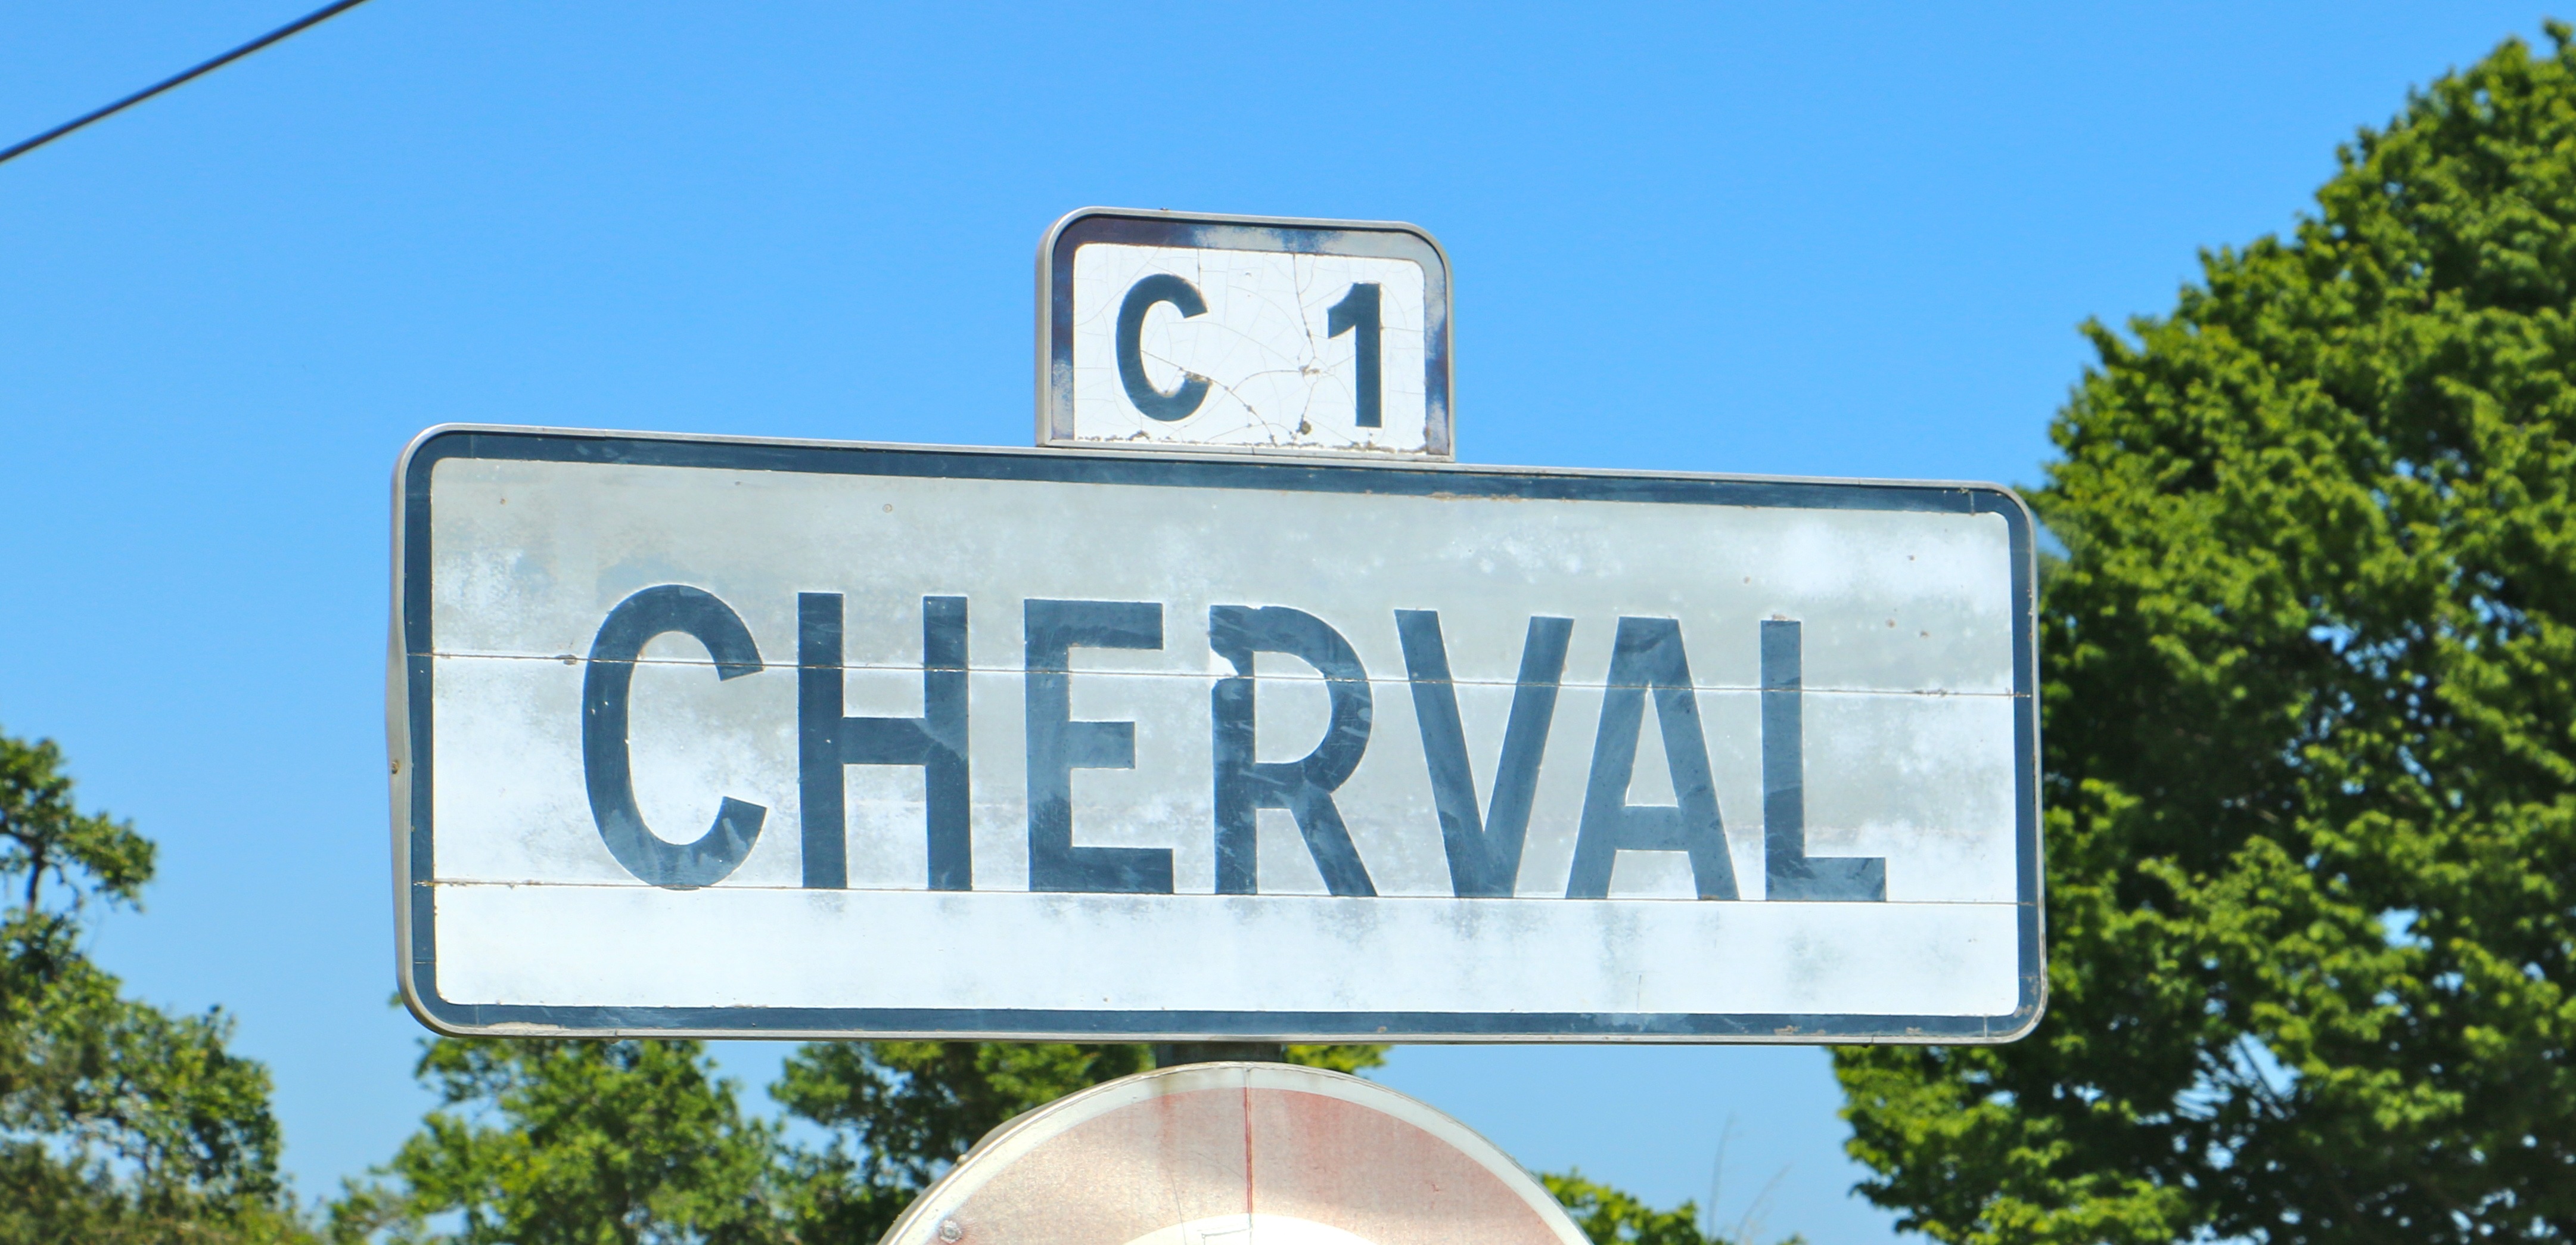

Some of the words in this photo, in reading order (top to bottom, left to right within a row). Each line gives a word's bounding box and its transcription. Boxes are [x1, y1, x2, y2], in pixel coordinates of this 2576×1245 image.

[1115, 273, 1212, 422] C
[1327, 282, 1382, 428] 1
[582, 583, 1887, 902] CHERVAL
